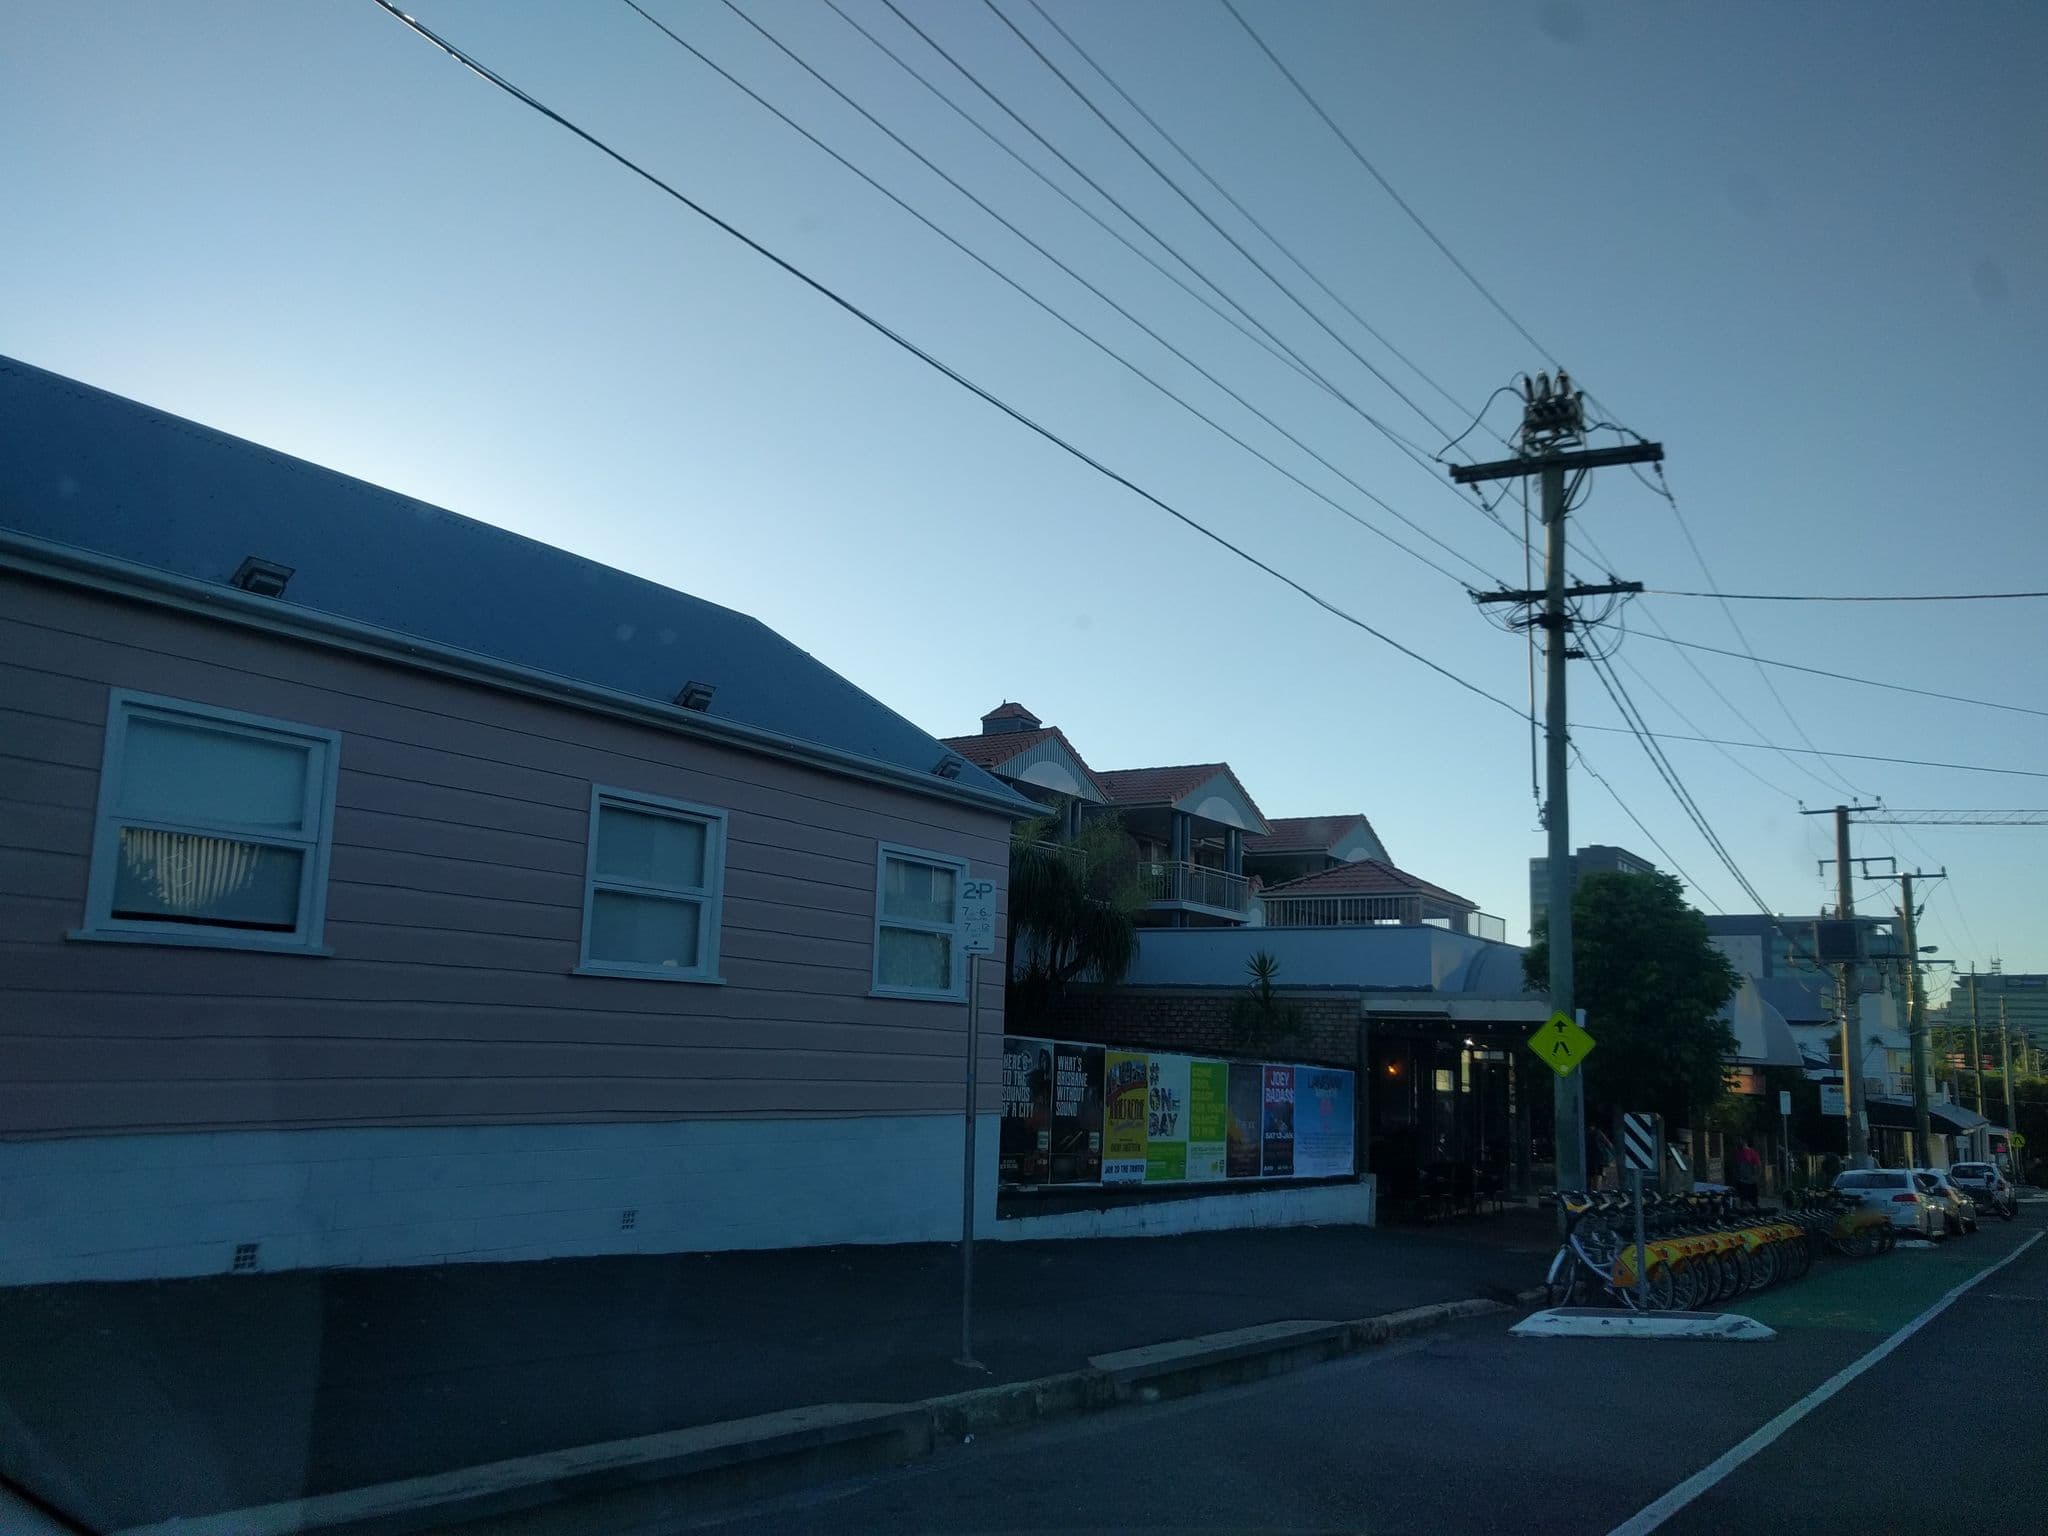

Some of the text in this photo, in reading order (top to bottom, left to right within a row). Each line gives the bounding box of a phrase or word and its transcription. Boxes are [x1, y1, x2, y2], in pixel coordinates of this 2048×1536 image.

[963, 881, 993, 900] 2P
[1057, 1055, 1082, 1072] WHAT'S
[1056, 1071, 1088, 1087] BRISBANE
[1270, 1070, 1289, 1087] JOEY
[1001, 1086, 1030, 1102] SOUNDS
[1056, 1086, 1085, 1102] WITHOUT
[1019, 1102, 1035, 1118] CITY
[1149, 1112, 1178, 1137] DAY
